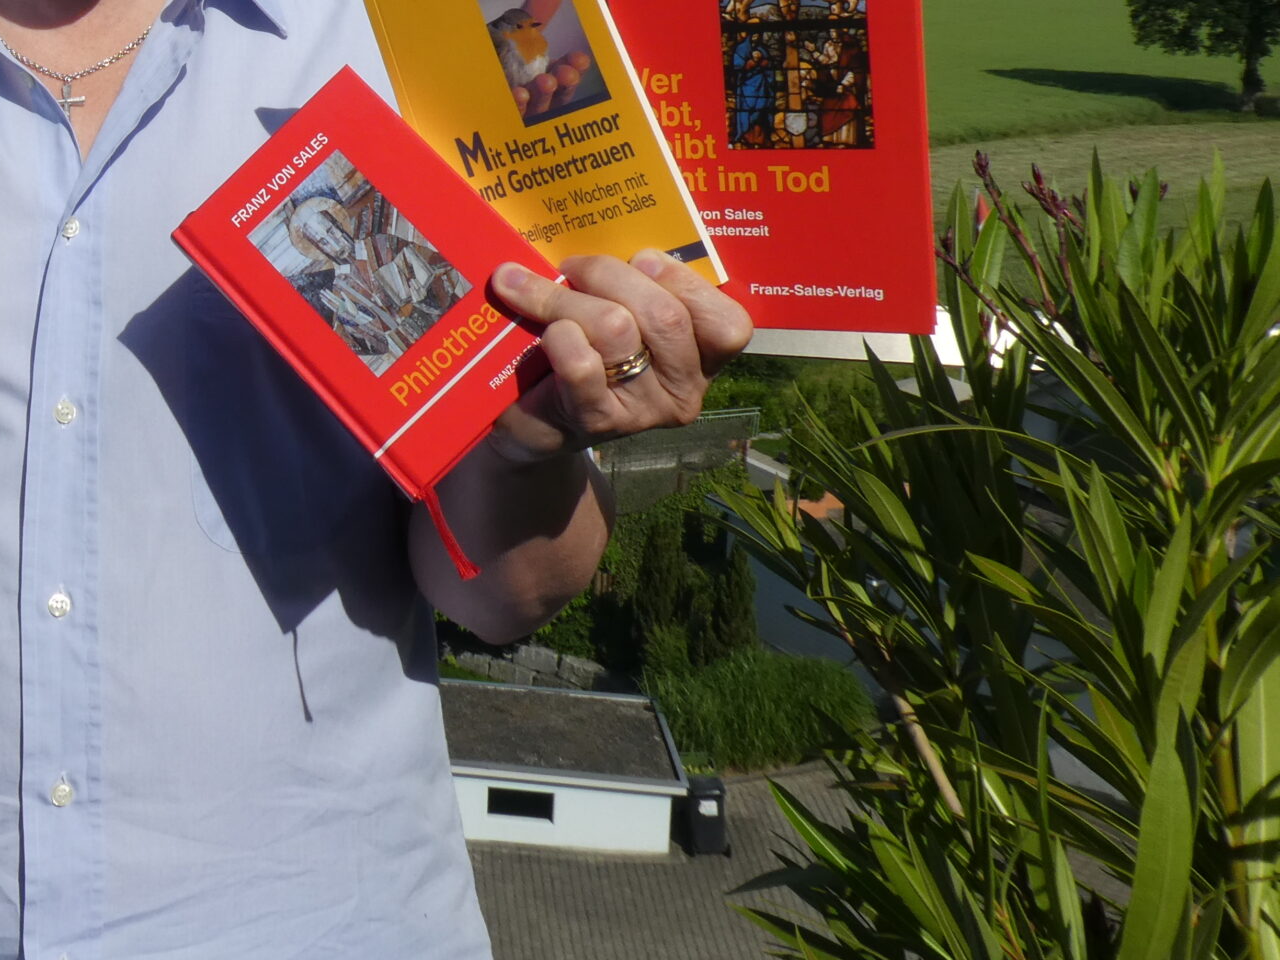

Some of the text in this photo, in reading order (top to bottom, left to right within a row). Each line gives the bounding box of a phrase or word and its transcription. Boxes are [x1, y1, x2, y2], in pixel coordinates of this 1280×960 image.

[454, 112, 621, 178] Mit Herz, Humor
[231, 132, 329, 228] FRANZ VON SALES
[508, 140, 635, 193] Gottvertrauen
[718, 165, 758, 192] im
[767, 165, 830, 193] Tod
[542, 172, 649, 216] Vier Wochen mit
[562, 211, 598, 233] Franz
[597, 204, 624, 223] von
[621, 192, 657, 214] Sales
[724, 208, 764, 220] Sales
[705, 224, 770, 237] astenzeit
[750, 283, 885, 301] Franz-Sales-Verlag
[390, 302, 502, 407] Philothea
